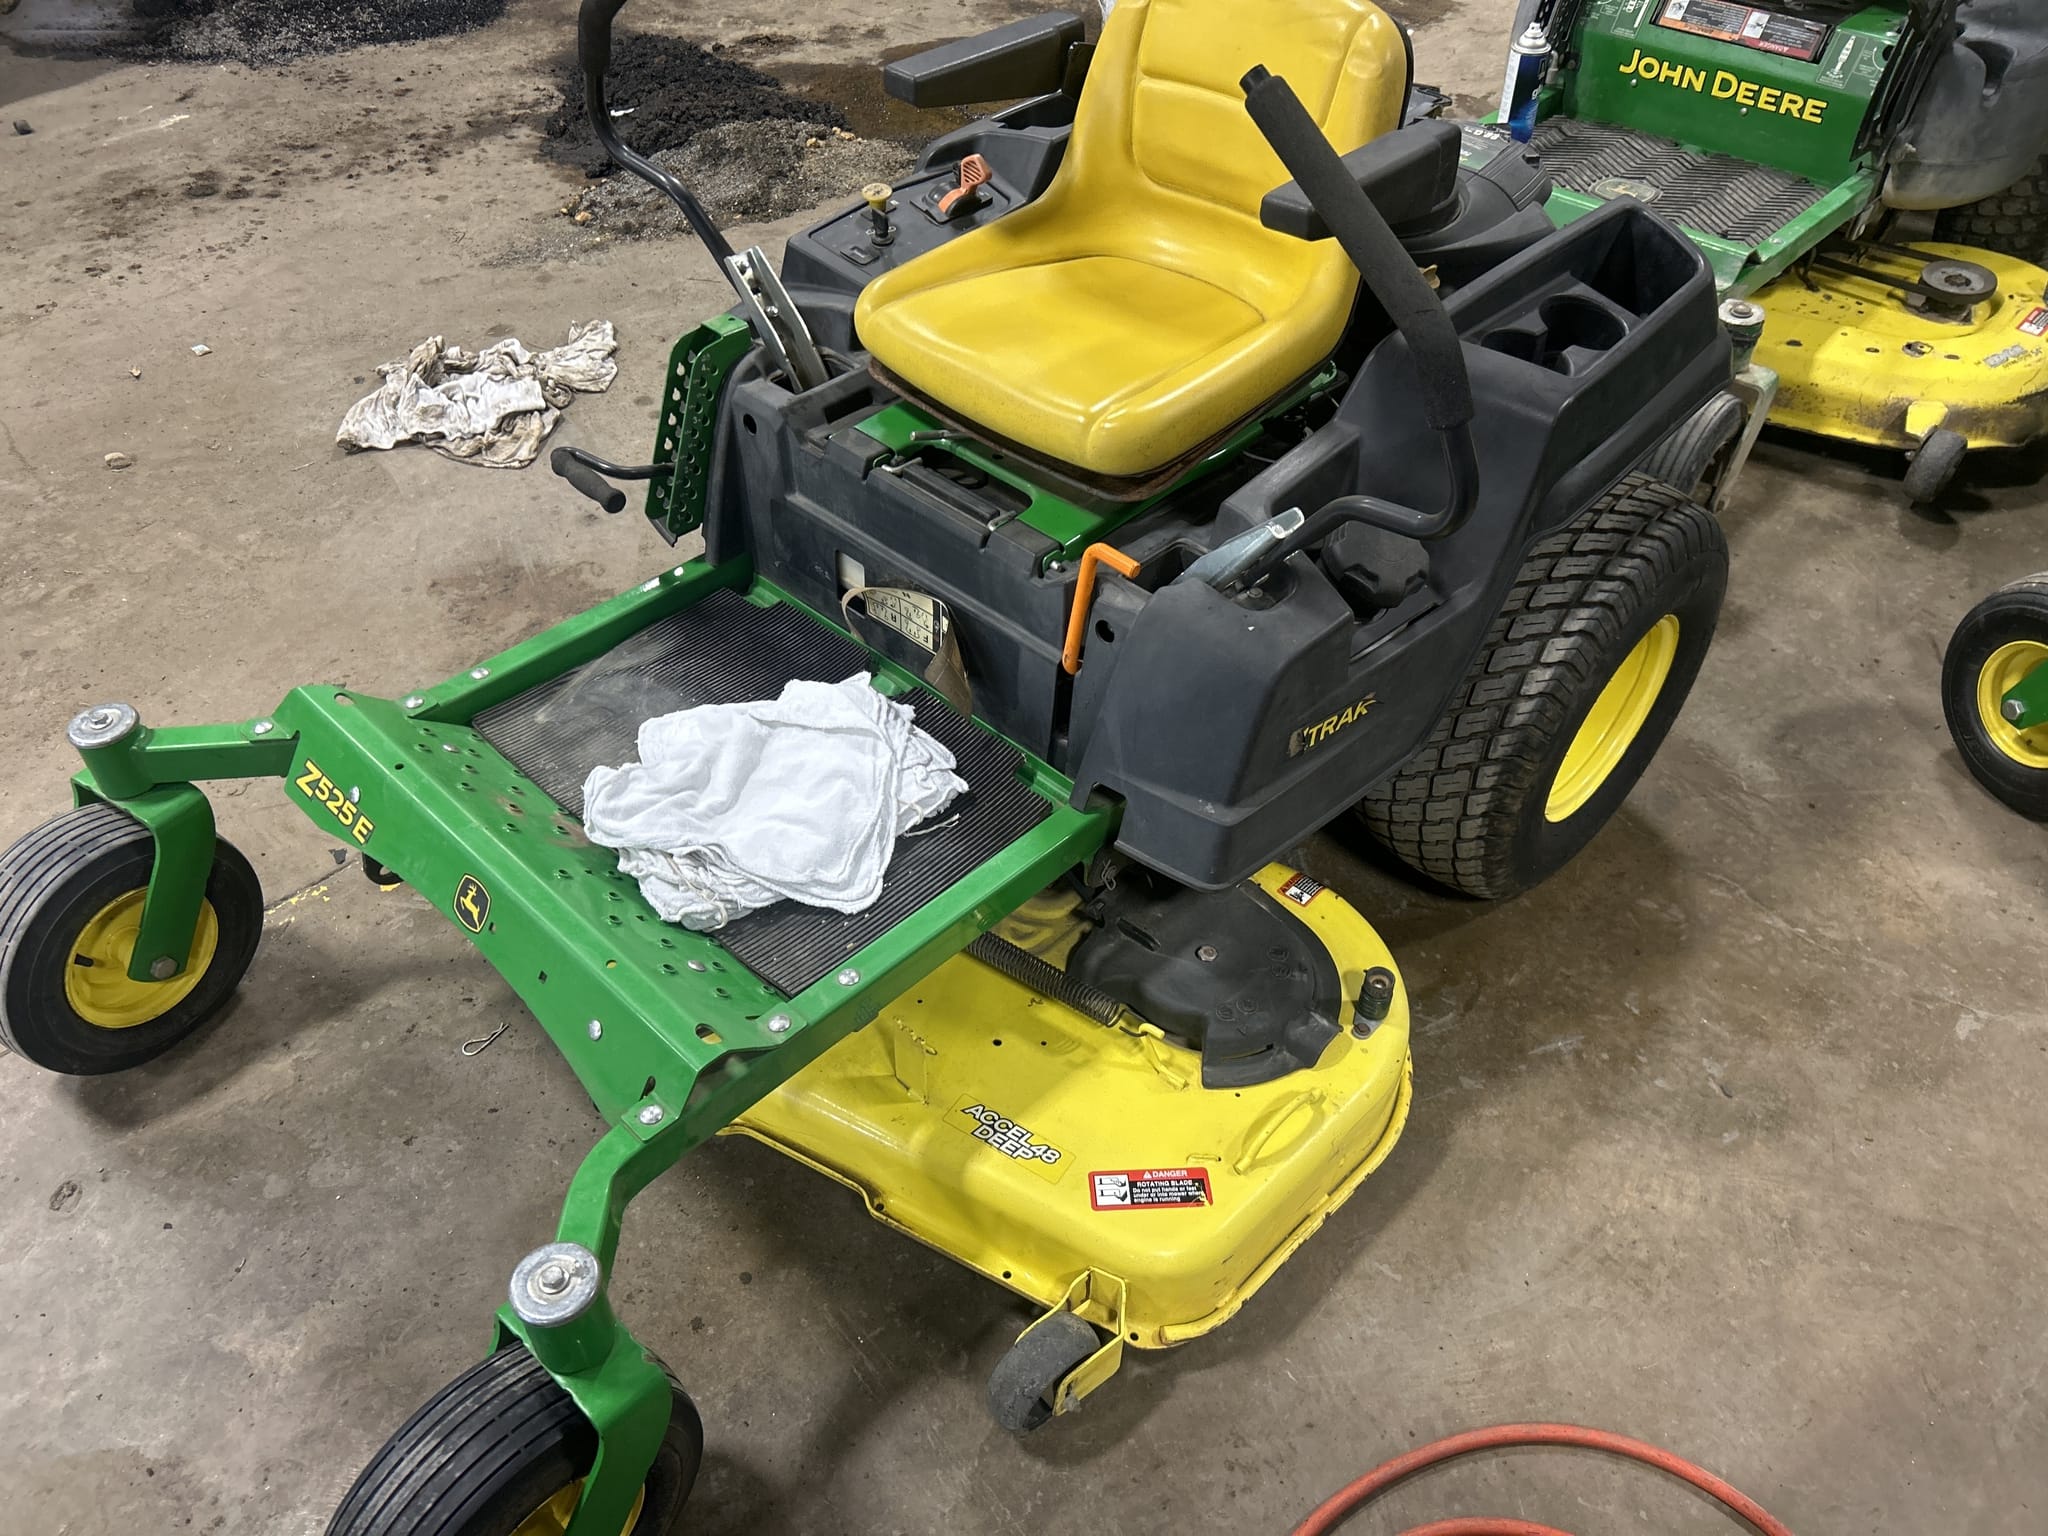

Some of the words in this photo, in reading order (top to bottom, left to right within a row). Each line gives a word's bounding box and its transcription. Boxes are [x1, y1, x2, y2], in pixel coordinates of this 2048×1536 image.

[1618, 48, 1707, 93] JOHN
[1710, 70, 1828, 124] DEERE
[1303, 700, 1377, 749] TRAK
[960, 1104, 1034, 1148] ACCEL
[970, 1124, 1034, 1160] DEEP
[1028, 1145, 1061, 1164] 48
[1152, 1169, 1187, 1178] DANGER
